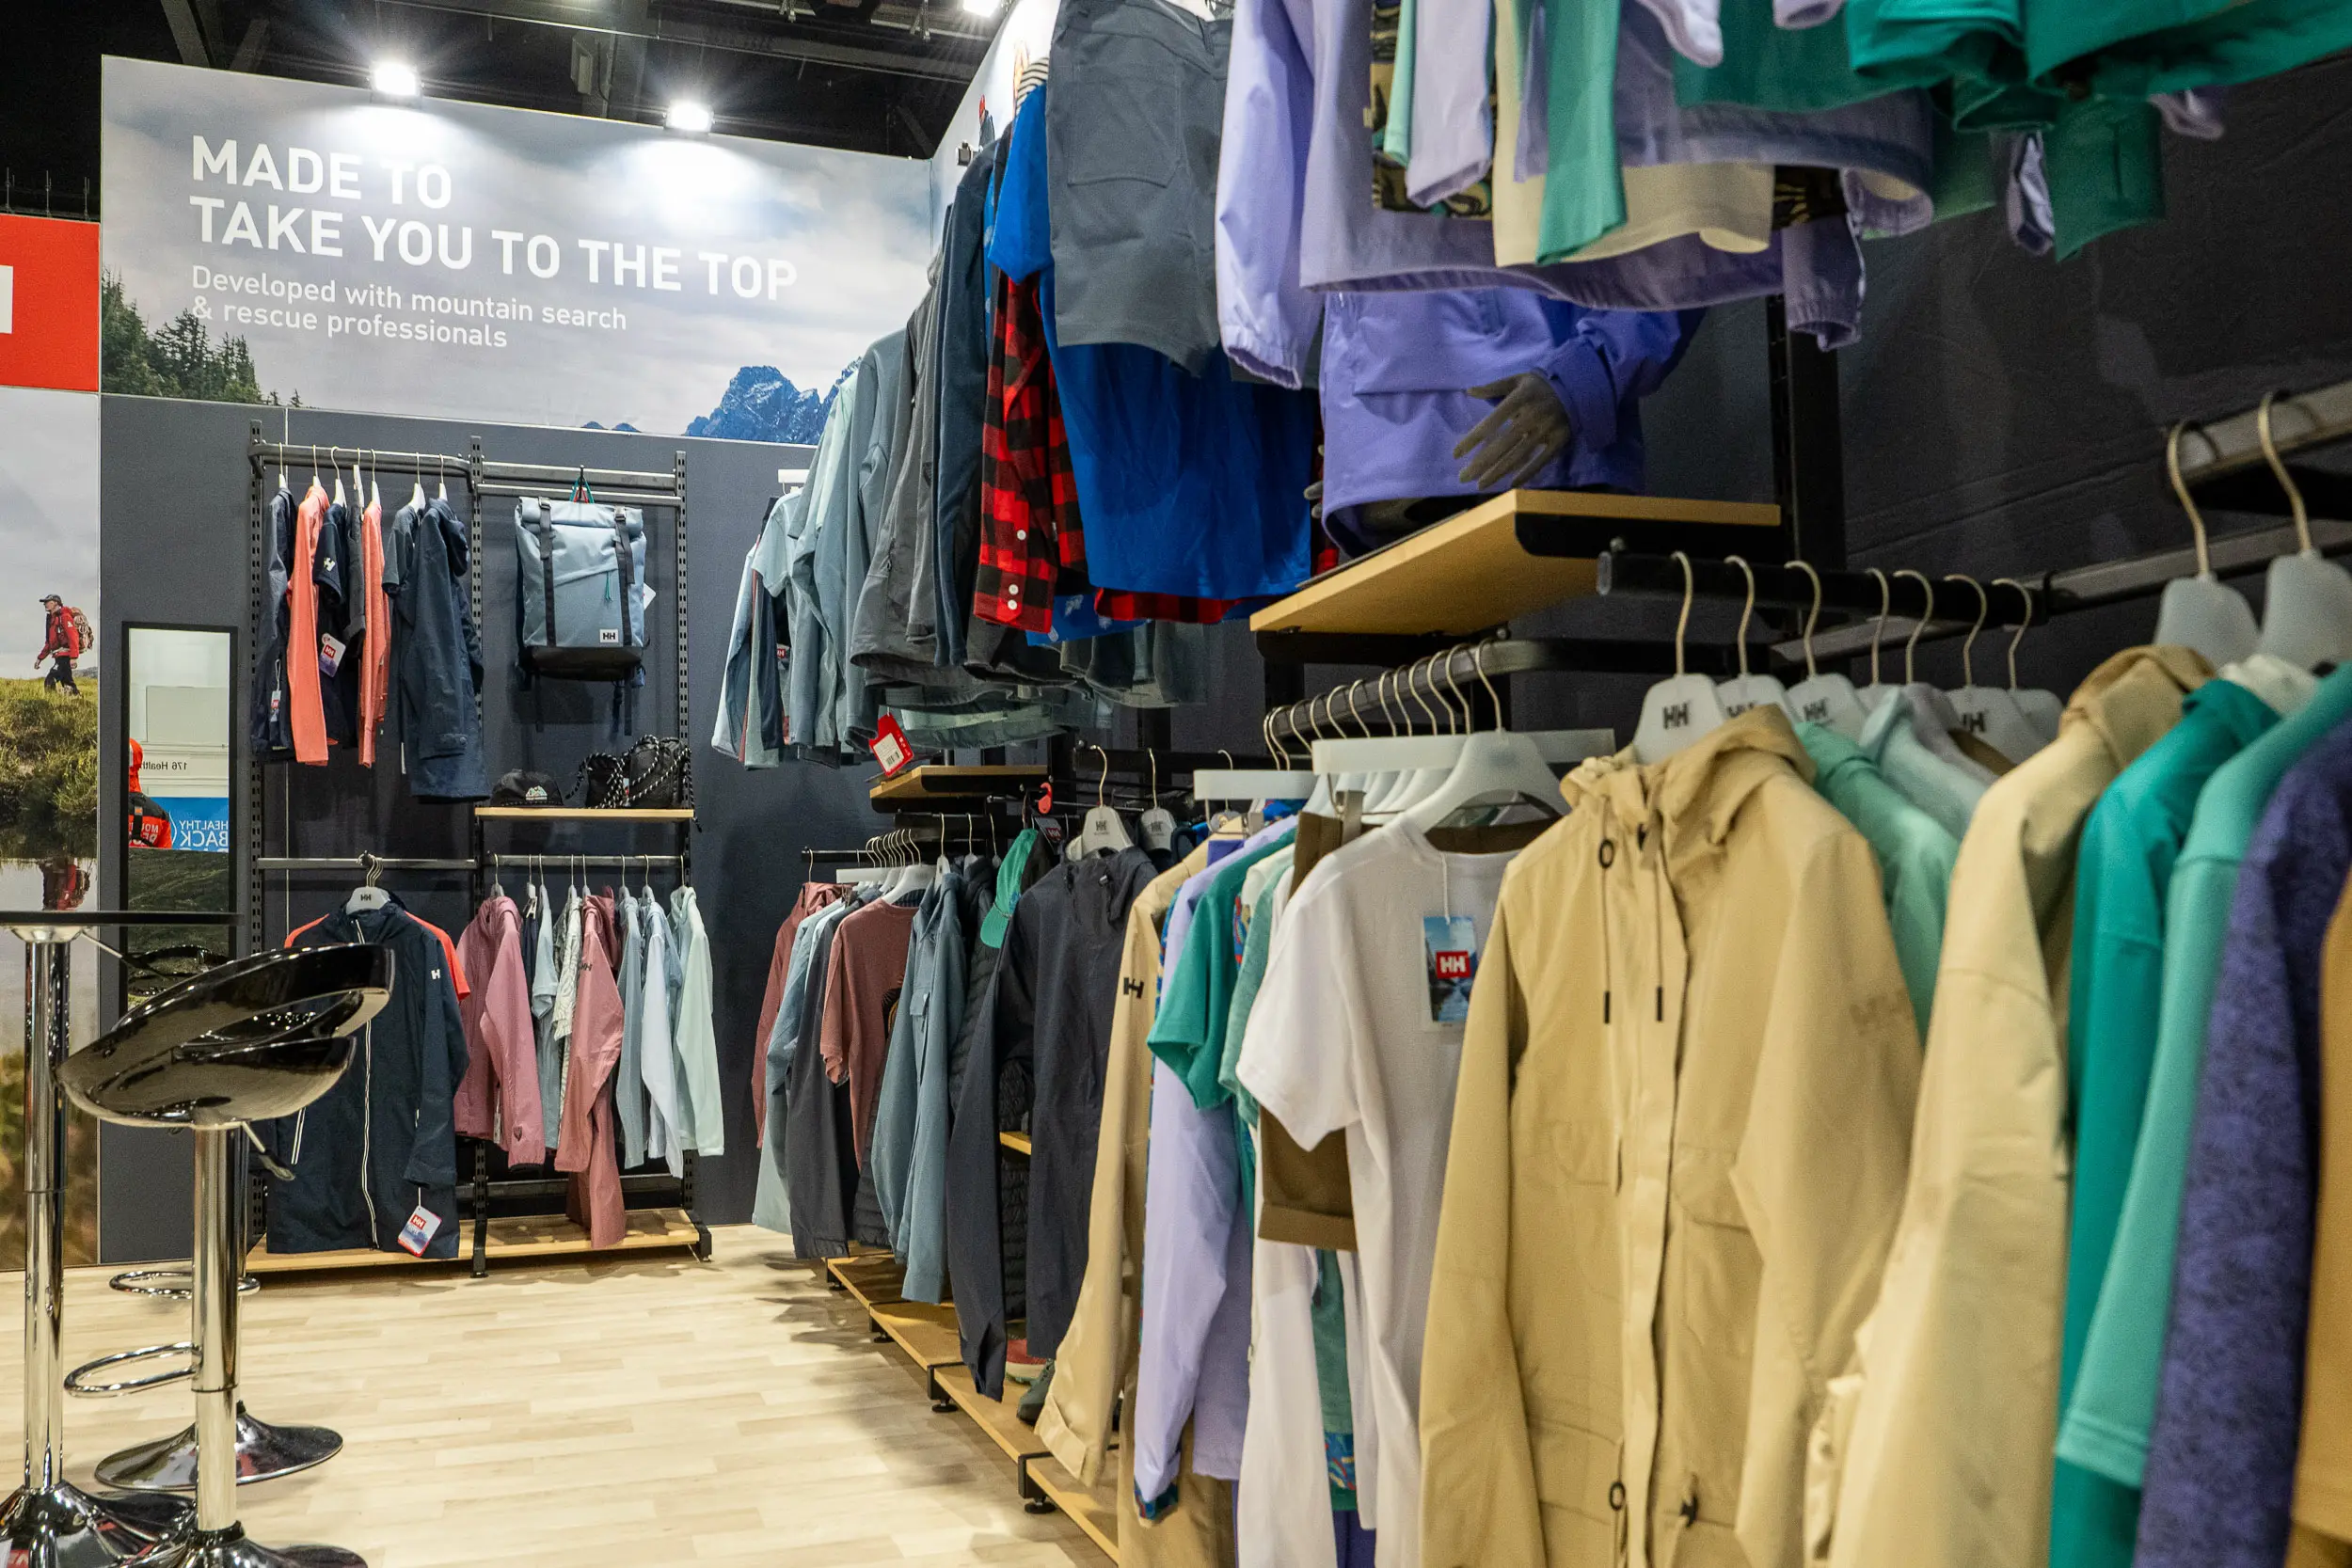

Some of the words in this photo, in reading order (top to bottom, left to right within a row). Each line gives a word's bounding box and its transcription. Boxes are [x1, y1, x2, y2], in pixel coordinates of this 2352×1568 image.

[193, 135, 362, 199] MADE
[380, 158, 452, 209] TO
[189, 196, 343, 257] TAKE
[361, 215, 472, 270] YOU
[491, 230, 561, 278] TO
[578, 239, 682, 292] THE
[697, 252, 798, 301] TOP
[193, 265, 336, 304] Developed
[344, 284, 402, 309] with
[411, 293, 533, 322] mountain
[542, 307, 627, 330] search
[193, 295, 213, 320] &
[224, 304, 317, 330] rescue
[327, 313, 507, 348] professionals
[1663, 704, 1690, 729] HH
[1804, 699, 1829, 721] HH
[1439, 956, 1467, 974] HH
[413, 1216, 424, 1227] HH
